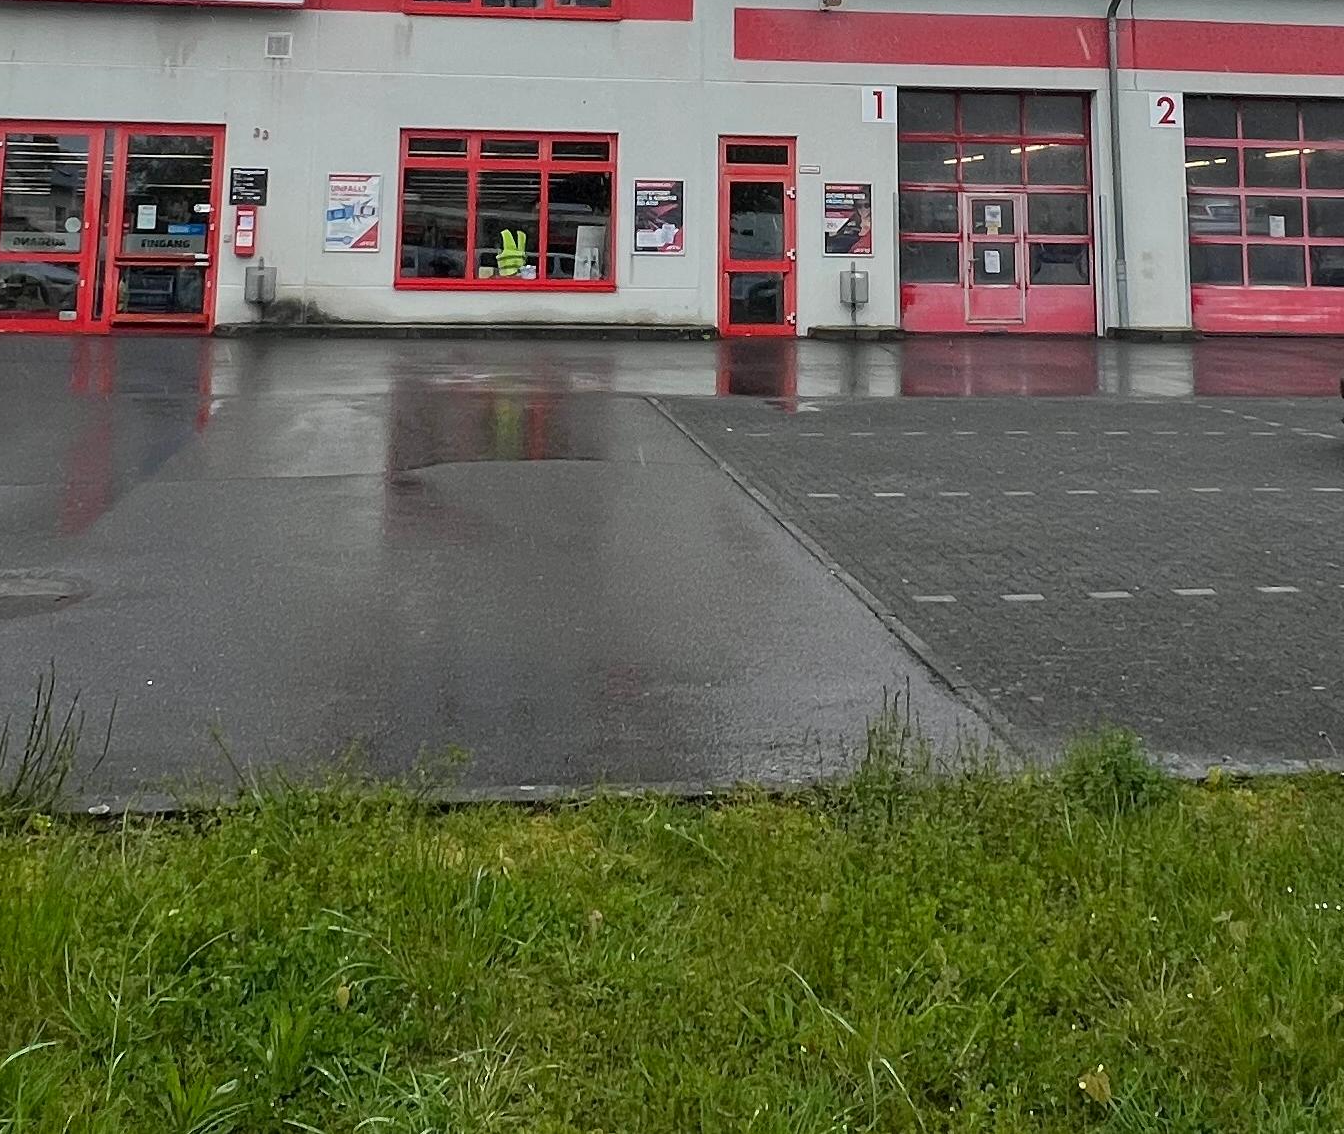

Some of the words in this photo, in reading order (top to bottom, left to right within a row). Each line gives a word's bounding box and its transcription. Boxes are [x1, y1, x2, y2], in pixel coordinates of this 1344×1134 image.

[872, 90, 883, 119] 1
[1156, 96, 1176, 124] 2
[140, 239, 191, 249] EINGANG
